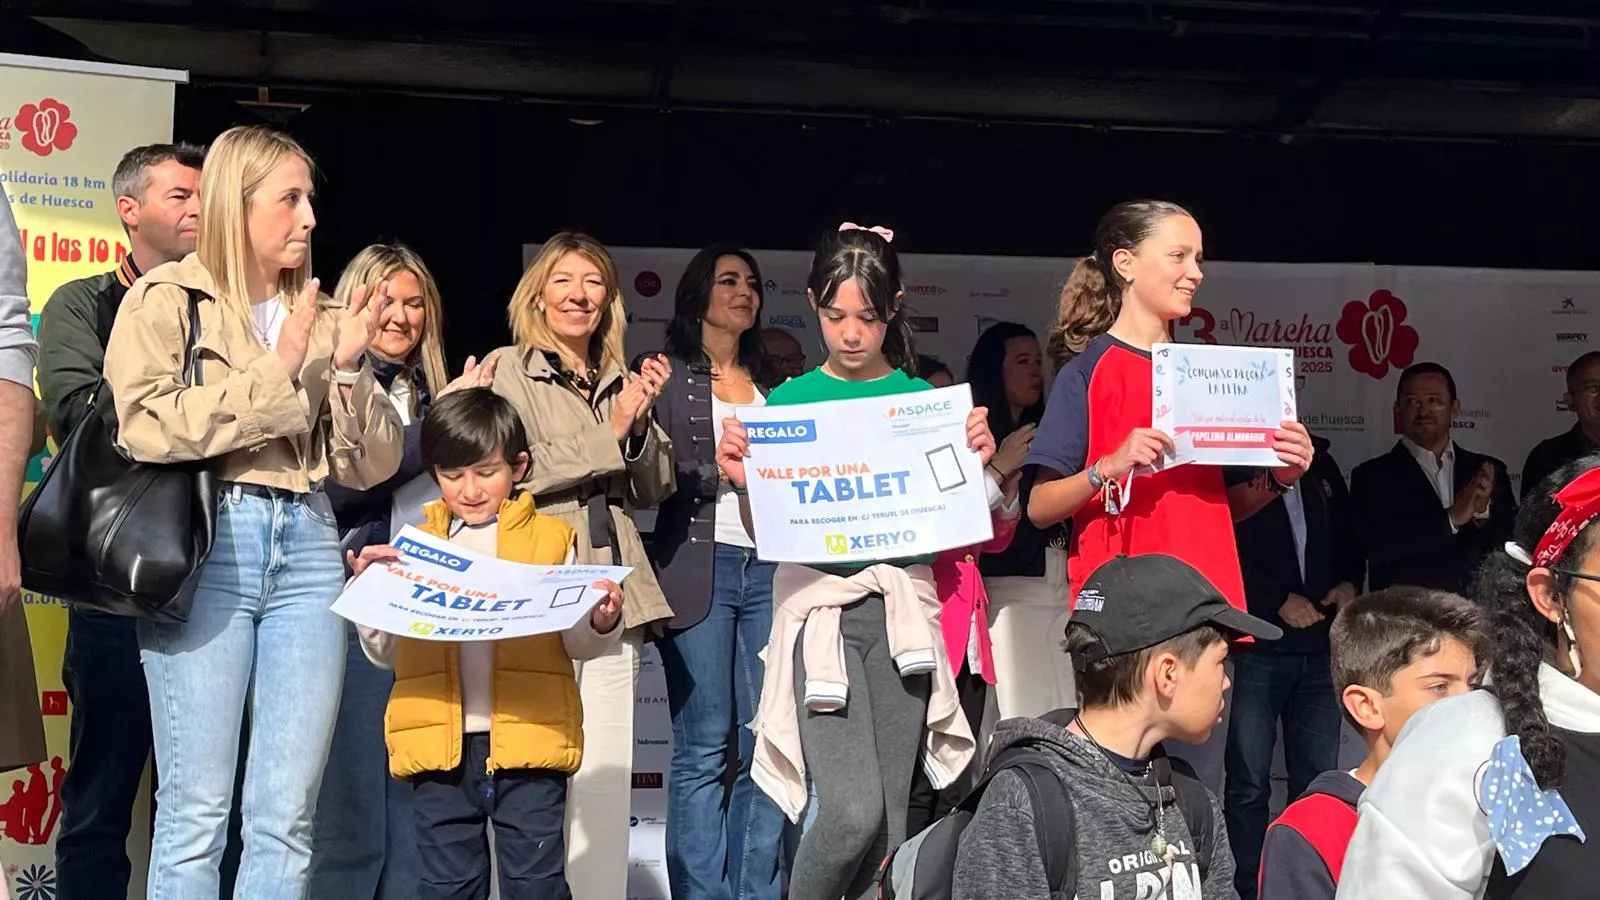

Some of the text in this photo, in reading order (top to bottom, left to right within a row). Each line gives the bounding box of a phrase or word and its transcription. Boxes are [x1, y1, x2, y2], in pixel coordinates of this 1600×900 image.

[0, 171, 106, 189] olidaria 18 km
[20, 194, 37, 204] de
[42, 194, 94, 208] Huesca
[34, 236, 46, 261] a
[52, 232, 82, 262] las
[89, 238, 109, 263] 10
[1231, 308, 1334, 343] Marcha
[1295, 346, 1333, 358] UESCA
[1301, 362, 1333, 373] 2025
[897, 401, 952, 417] ASPACE
[1304, 412, 1365, 425] de huesca
[1452, 420, 1475, 429] esca
[747, 425, 807, 439] REGALO
[757, 461, 871, 480] VALE POR UNA
[791, 470, 911, 504] TABLET
[790, 517, 810, 526] PARA
[811, 516, 846, 525] RECOGER
[849, 529, 917, 550] XERYO
[399, 541, 462, 567] REGALO
[387, 561, 498, 599] VALE POR UNA
[411, 583, 533, 613] TABLET
[434, 626, 504, 636] XERYO
